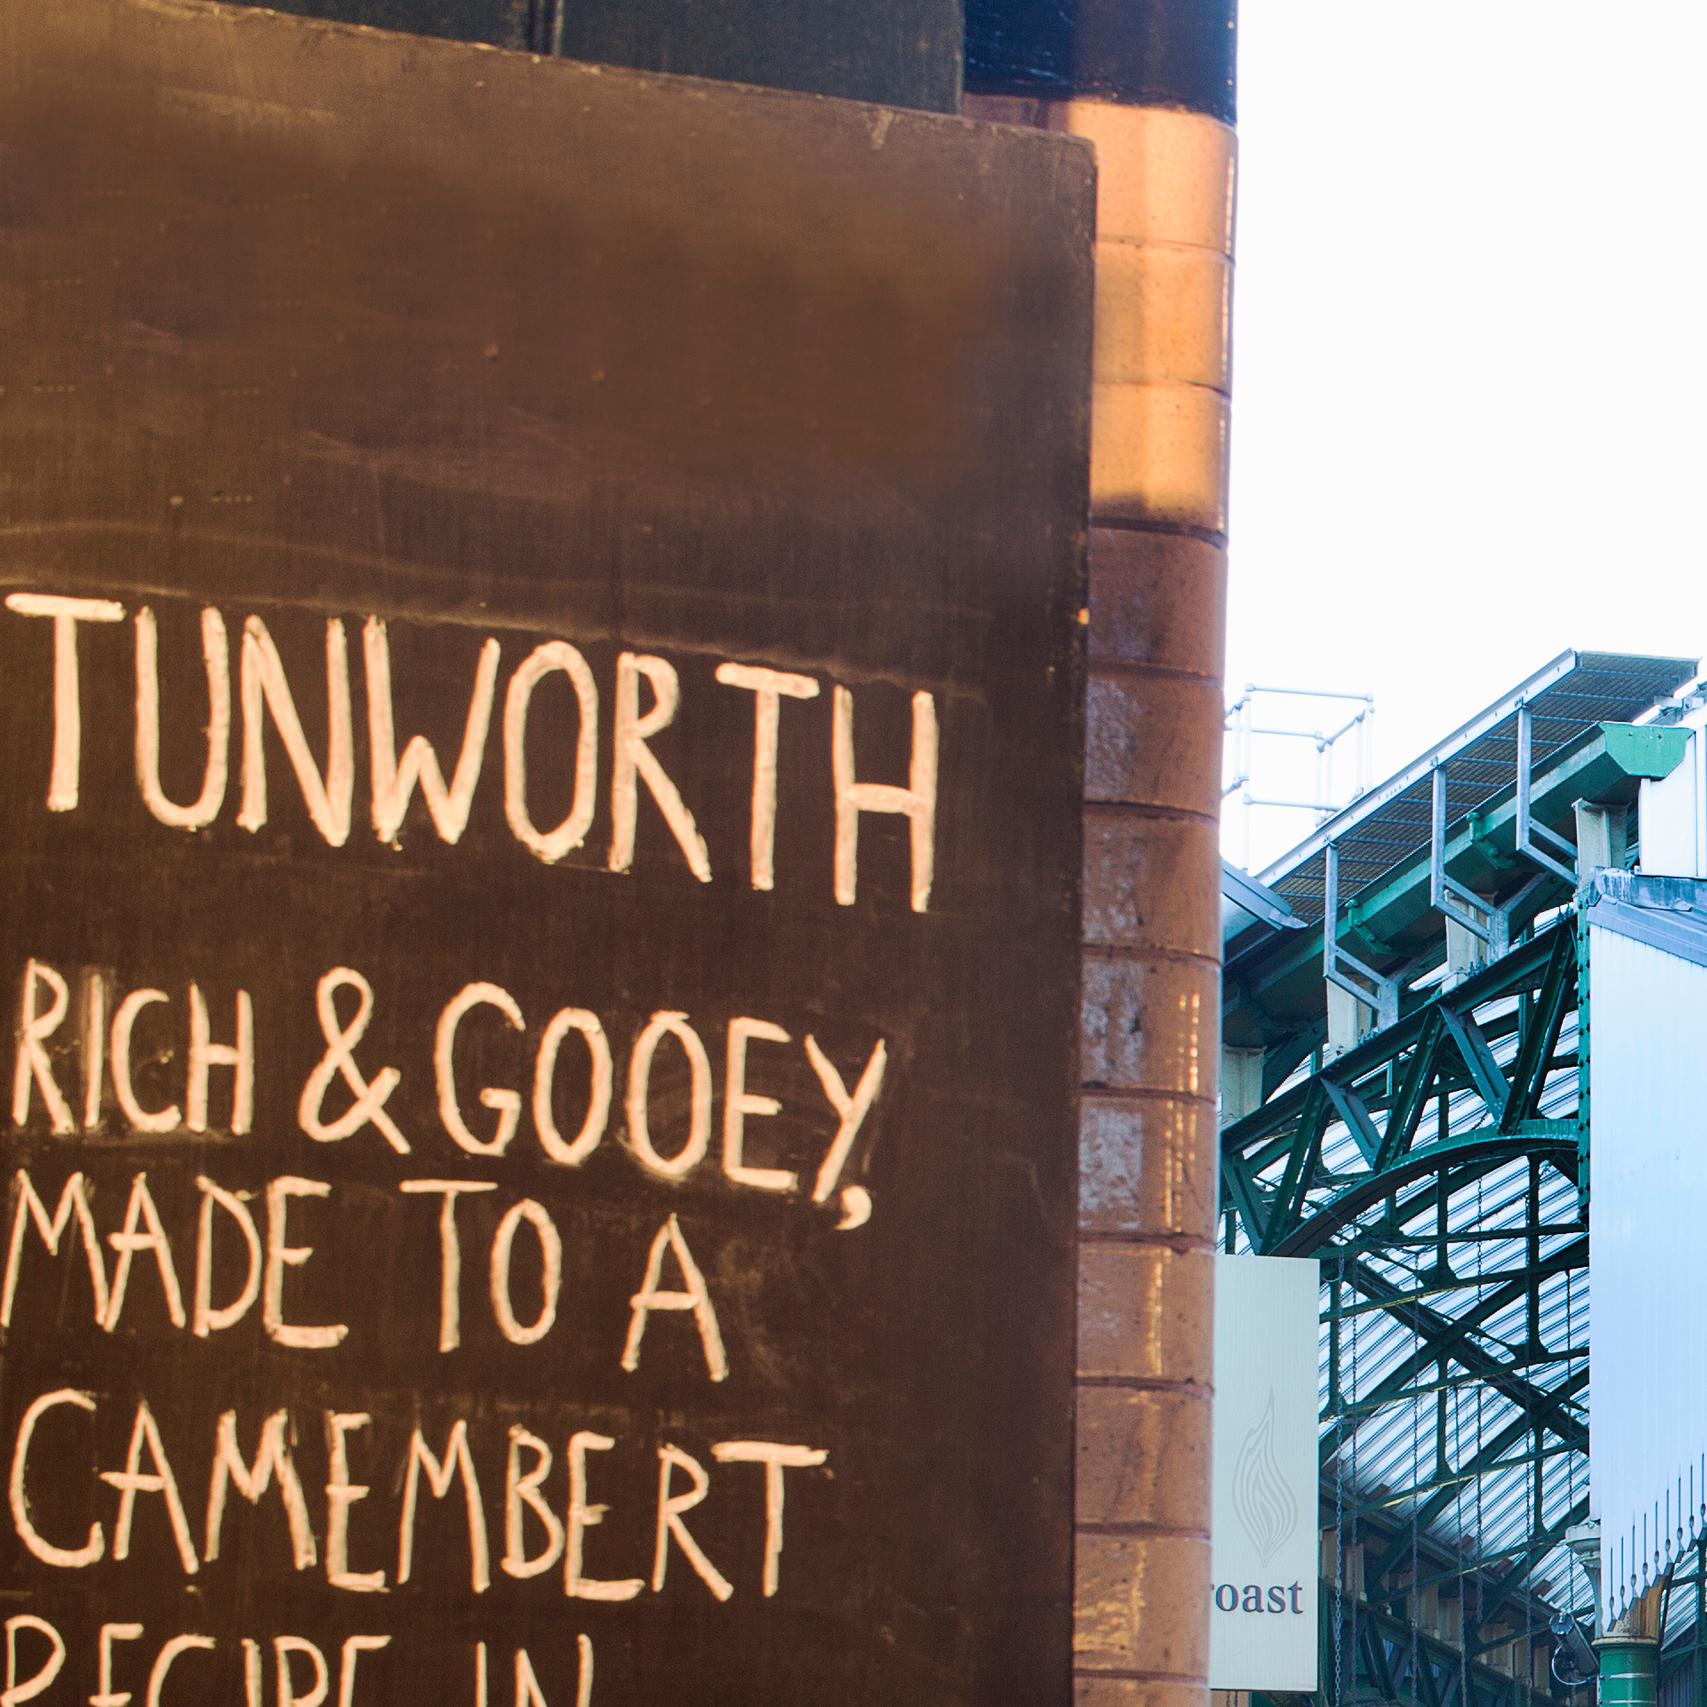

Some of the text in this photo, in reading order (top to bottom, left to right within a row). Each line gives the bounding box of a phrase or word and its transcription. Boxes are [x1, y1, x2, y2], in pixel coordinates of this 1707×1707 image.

[6, 592, 940, 912] TUNWORTH
[12, 957, 888, 1231] RICH & GOOEY,
[0, 1170, 731, 1383] MADE TO A
[8, 1389, 830, 1602] CAMEMBERT
[1210, 1580, 1303, 1614] oast
